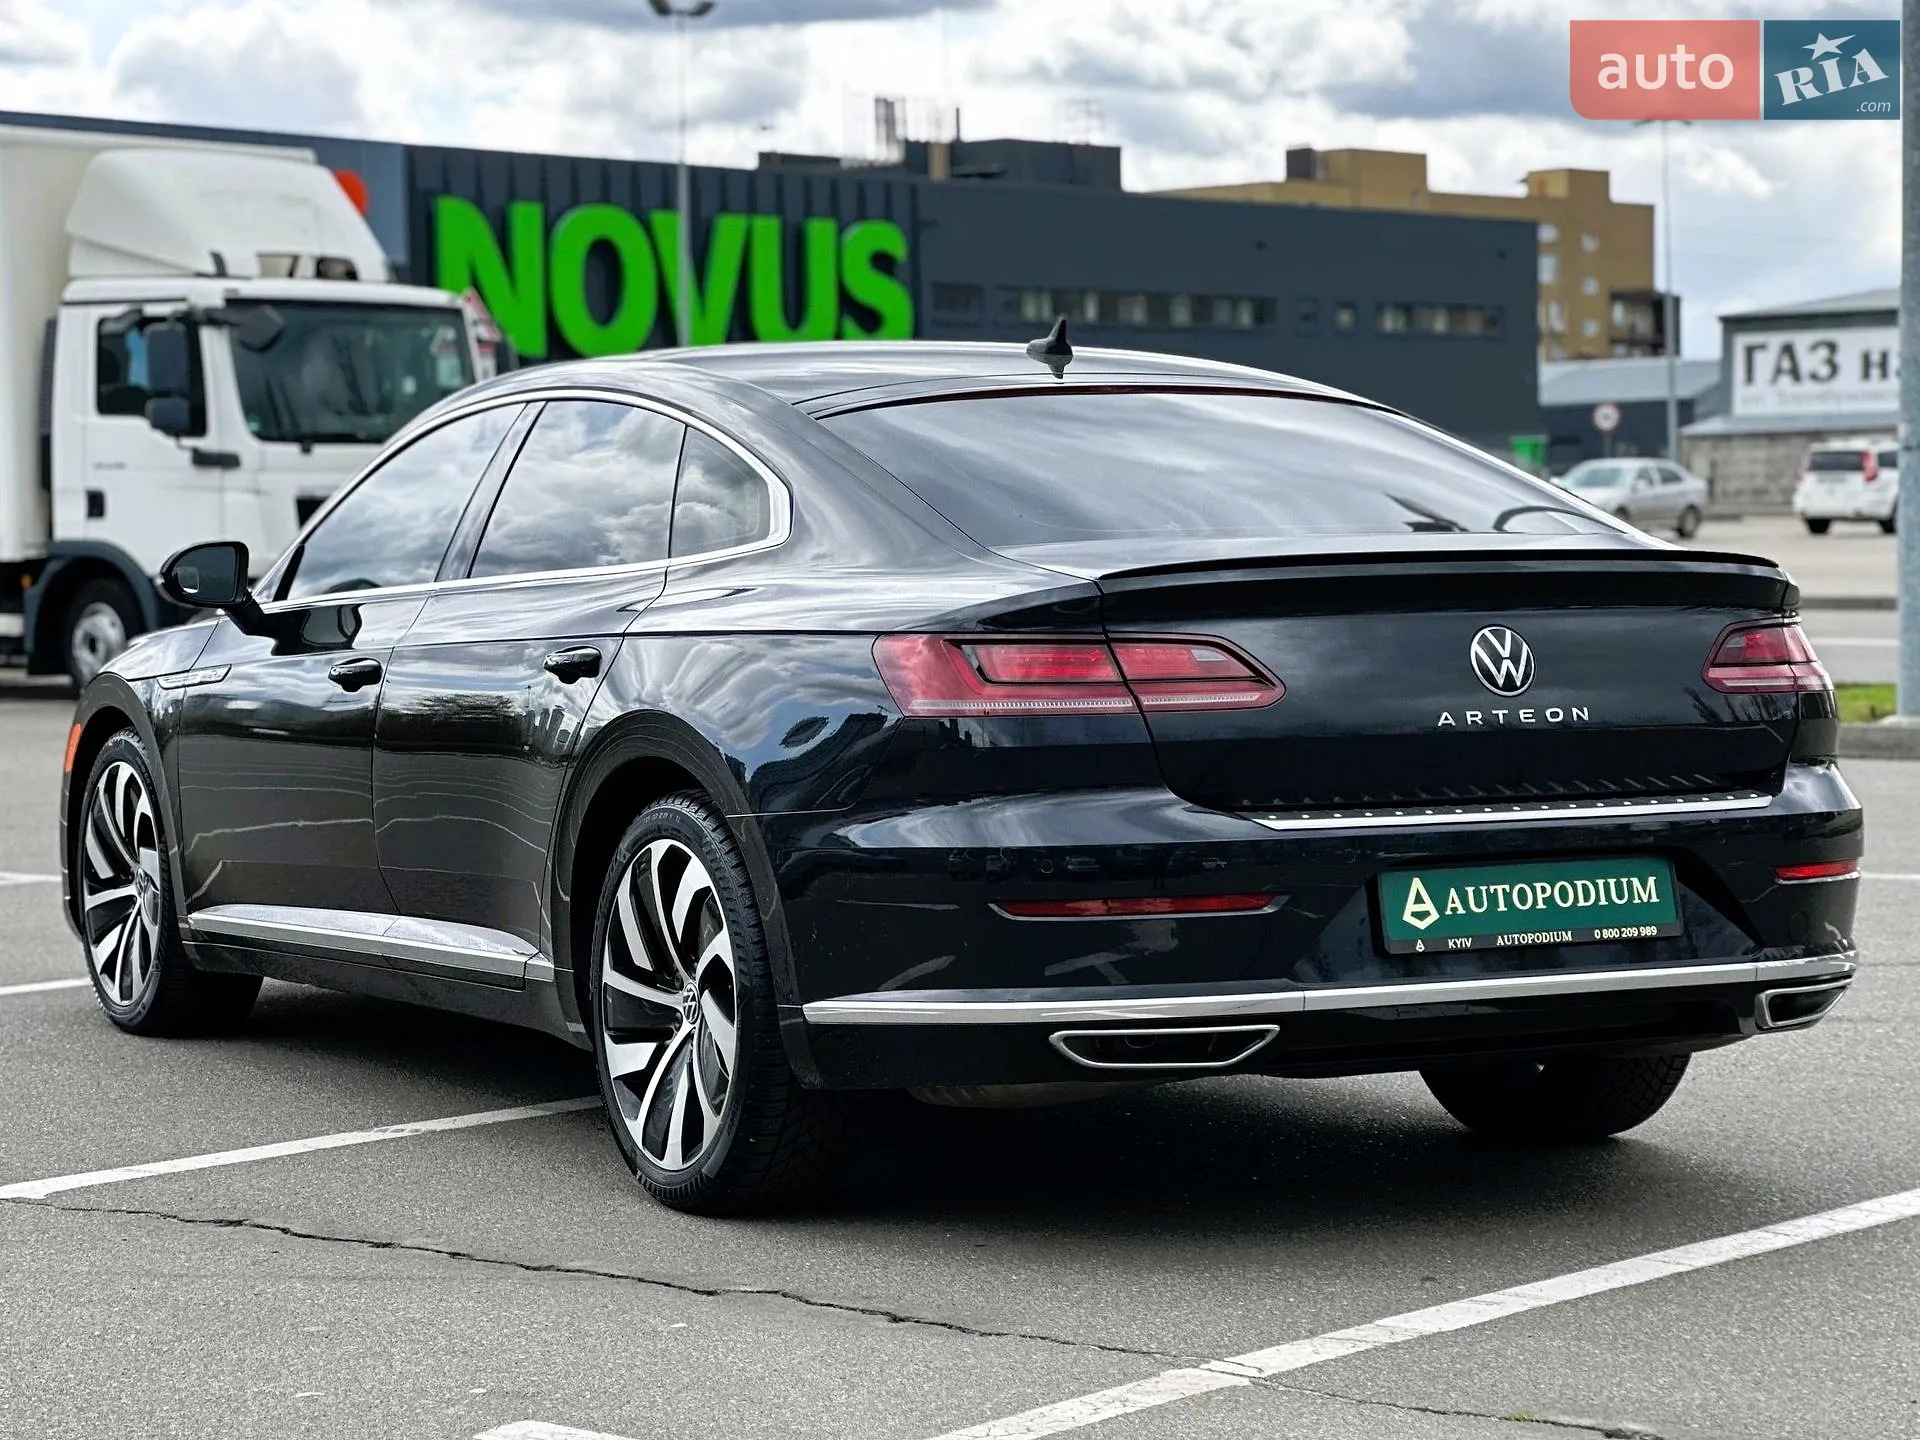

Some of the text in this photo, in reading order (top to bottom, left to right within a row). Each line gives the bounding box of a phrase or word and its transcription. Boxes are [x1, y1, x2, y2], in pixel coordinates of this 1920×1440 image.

[433, 195, 915, 358] NOVUS
[1742, 339, 1901, 386] ГАЗ н
[1437, 706, 1590, 728] ARTEON
[1445, 876, 1660, 916] AUTOPODIUM
[1447, 925, 1658, 949] KYIV AUTOPODIUM 0 800 209 989
